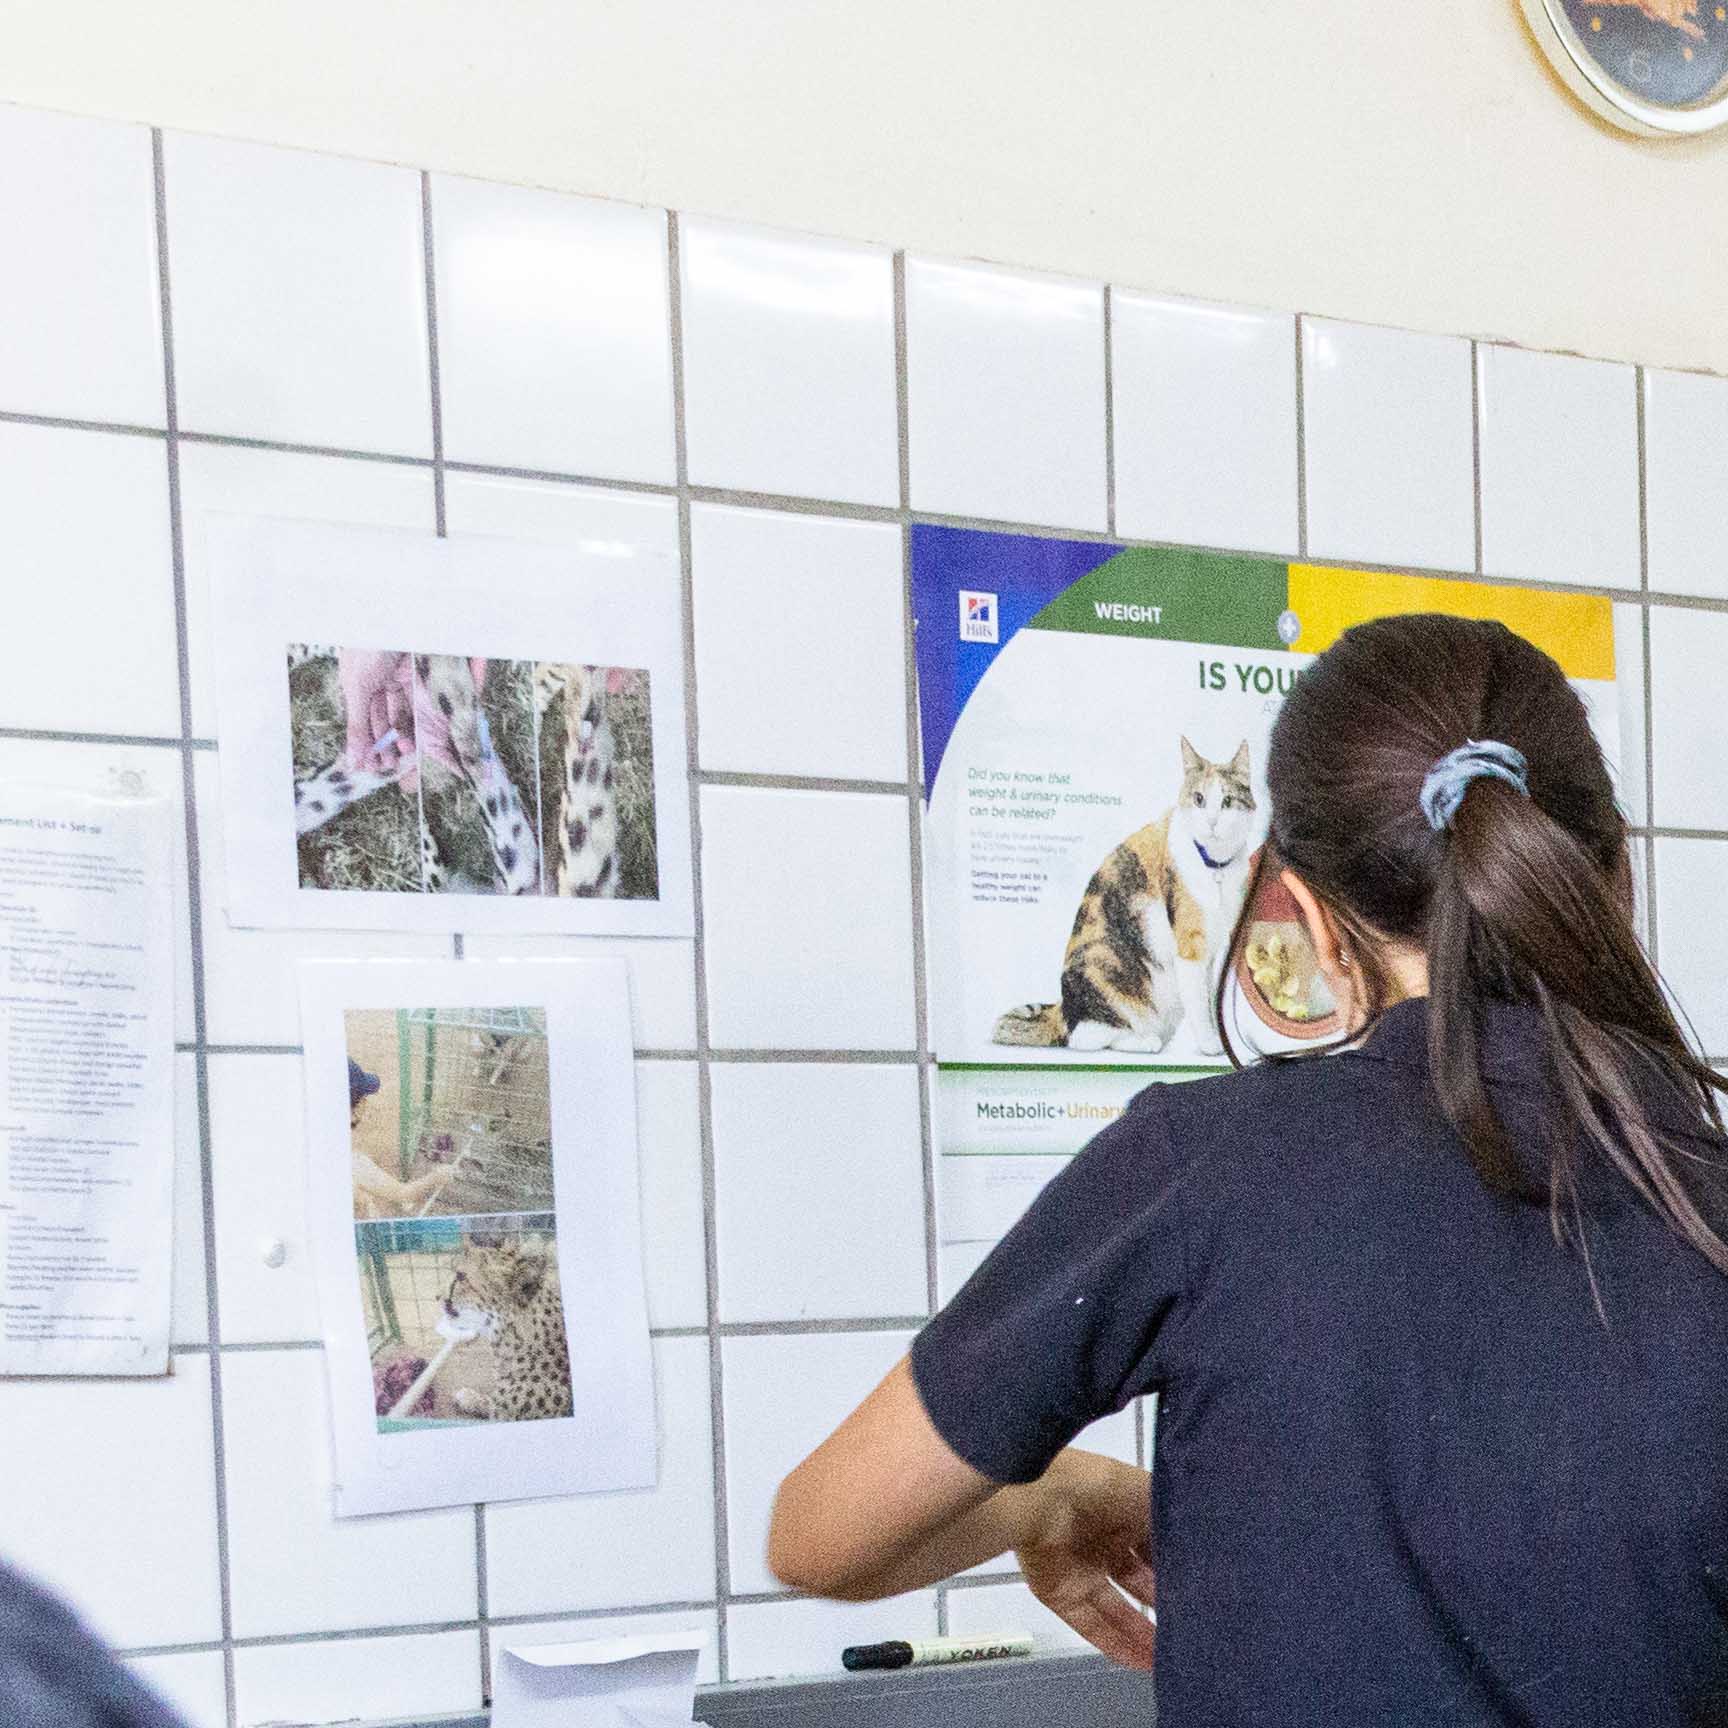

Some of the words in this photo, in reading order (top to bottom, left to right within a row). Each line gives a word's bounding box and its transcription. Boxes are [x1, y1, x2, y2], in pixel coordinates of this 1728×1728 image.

[1094, 602, 1163, 624] WEIGHT
[1199, 661, 1227, 691] IS
[1235, 664, 1300, 698] YOU
[967, 767, 988, 780] Did
[990, 770, 1012, 783] you
[1013, 770, 1044, 784] know
[1047, 772, 1073, 785] that
[967, 786, 1008, 801] weight
[1009, 788, 1018, 799] &
[1020, 789, 1061, 803] urinary
[1063, 791, 1123, 806] conditions
[969, 805, 989, 817] can
[991, 806, 1007, 818] be
